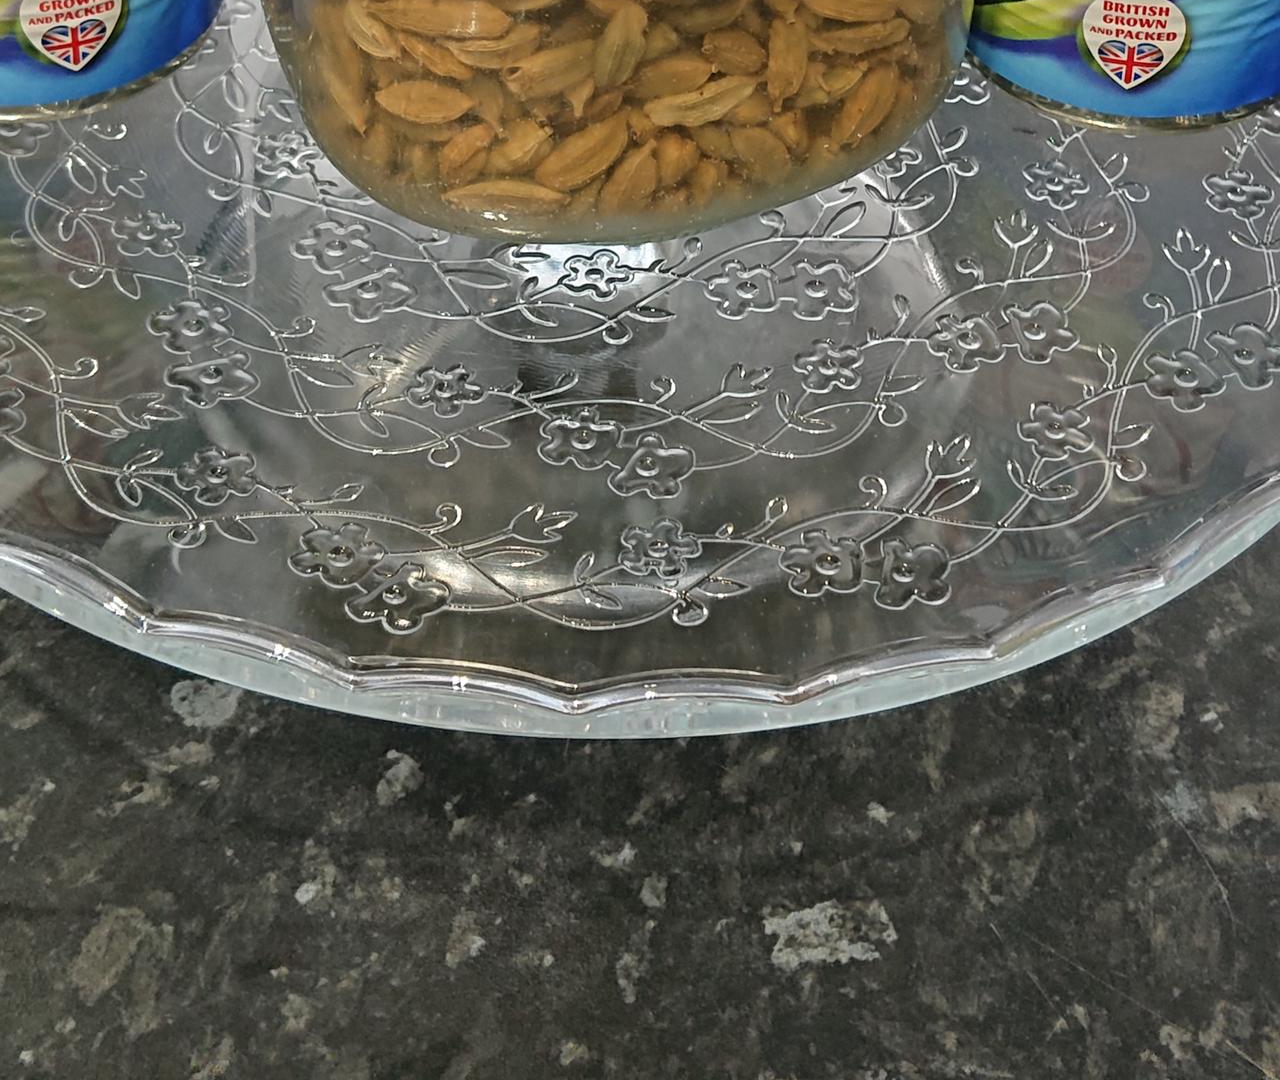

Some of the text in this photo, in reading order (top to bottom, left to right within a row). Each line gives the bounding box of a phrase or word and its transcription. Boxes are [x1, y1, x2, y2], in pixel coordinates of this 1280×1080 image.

[28, 0, 115, 26] AND PACKED
[1103, 0, 1170, 17] BRITISH
[1102, 13, 1168, 29] GROWN
[1089, 26, 1178, 42] AND PACKED
